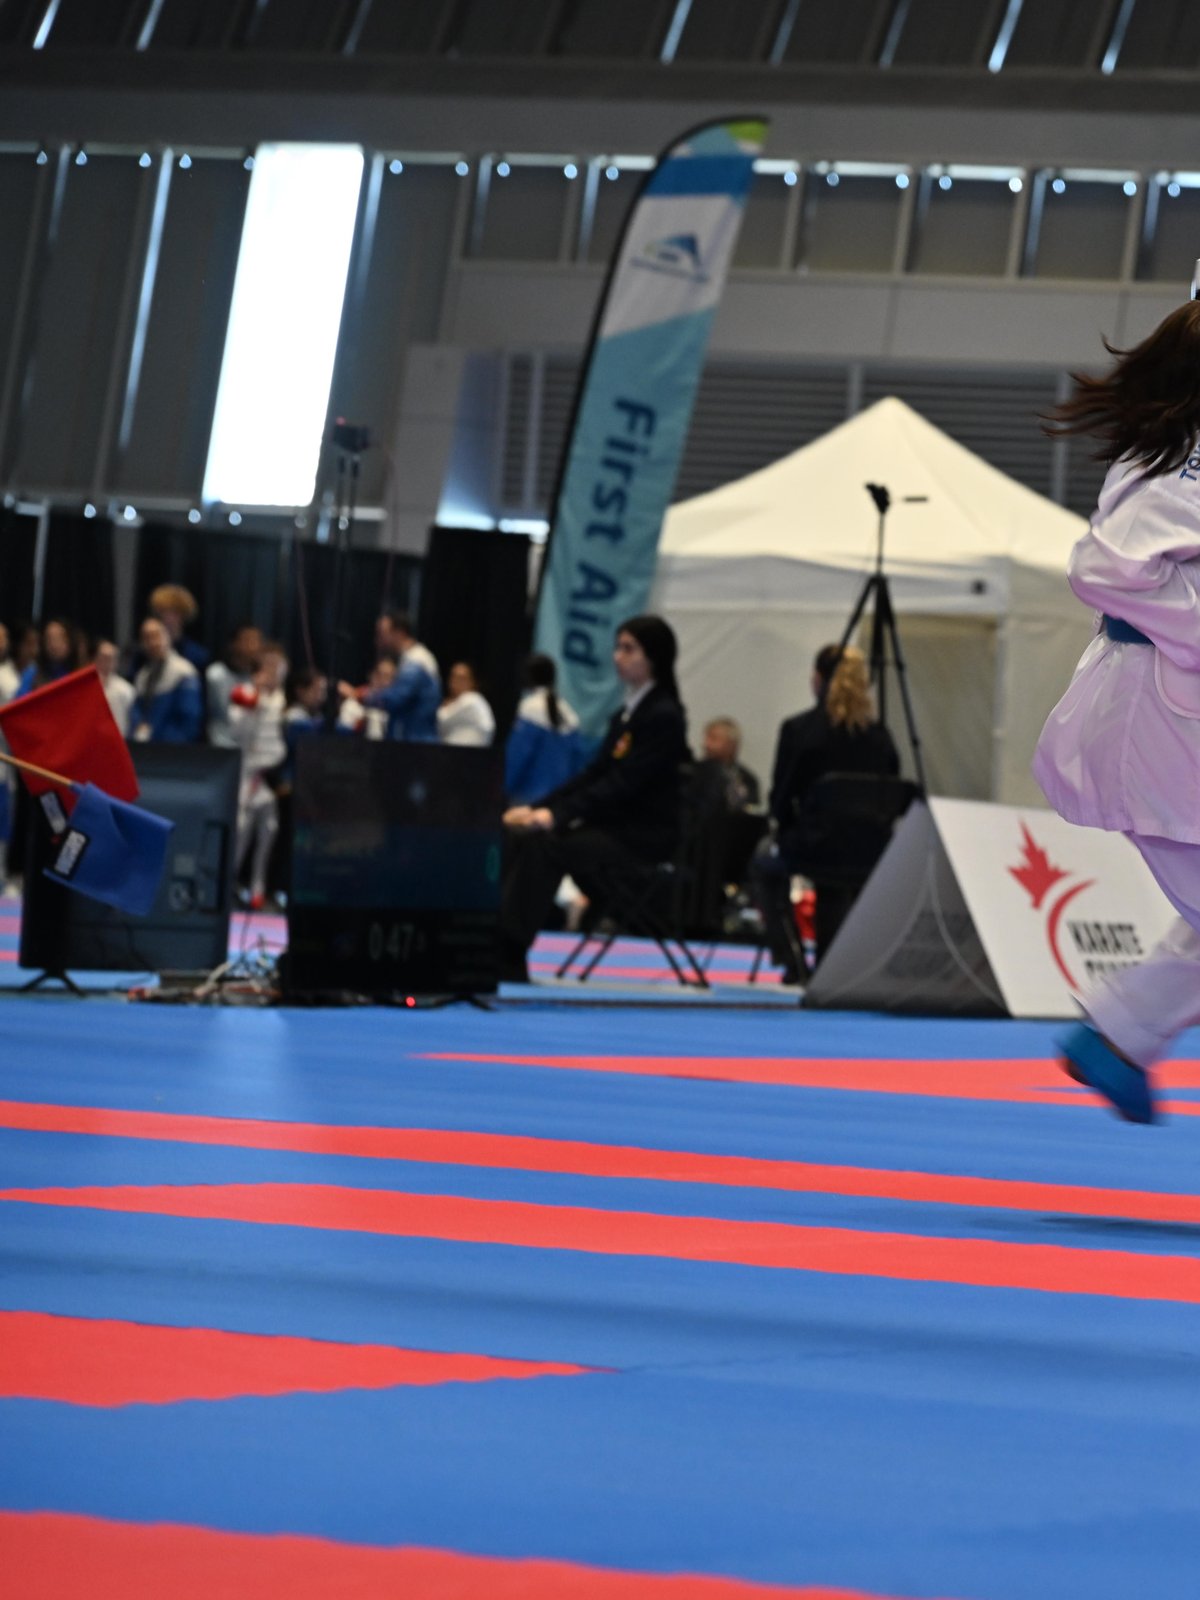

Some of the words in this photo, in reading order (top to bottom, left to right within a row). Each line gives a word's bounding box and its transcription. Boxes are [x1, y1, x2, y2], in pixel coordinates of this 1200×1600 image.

[584, 396, 657, 543] First
[563, 560, 618, 670] Aid
[1067, 921, 1143, 954] KARATE
